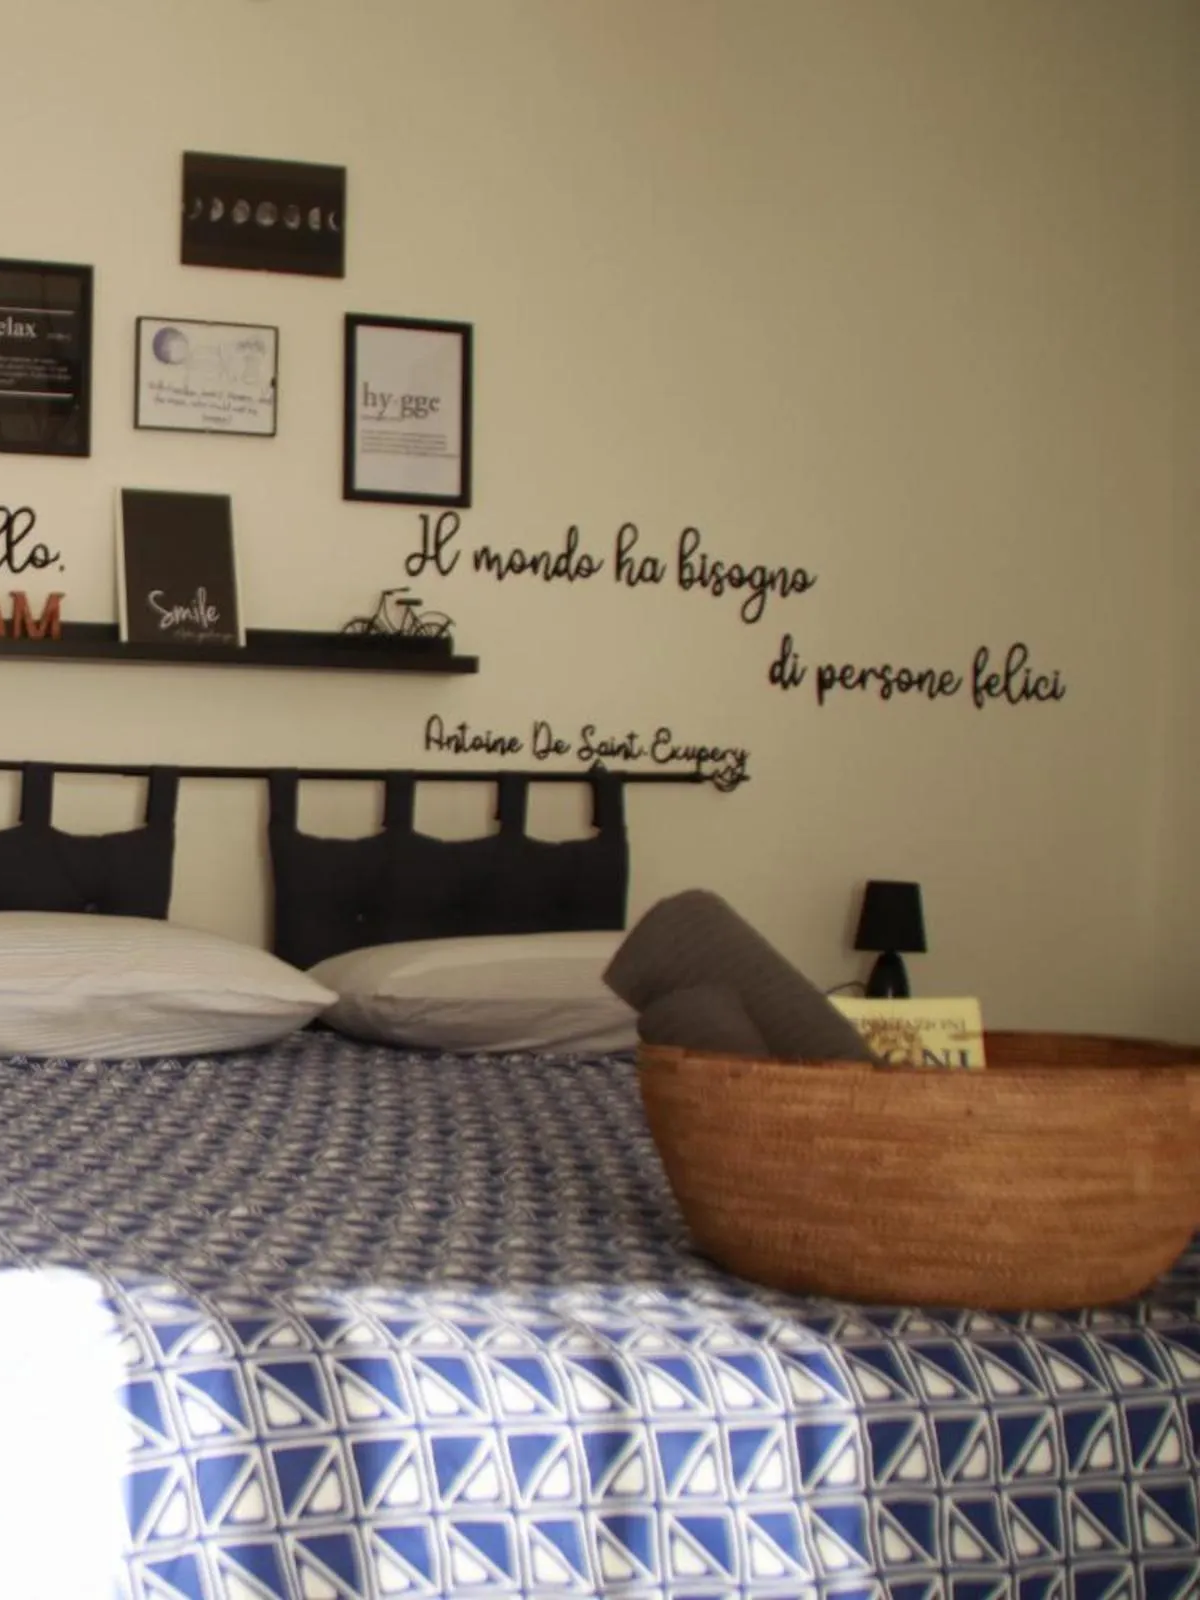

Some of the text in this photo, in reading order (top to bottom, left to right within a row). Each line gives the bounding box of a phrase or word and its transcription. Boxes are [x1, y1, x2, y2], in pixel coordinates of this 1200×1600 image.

[404, 510, 818, 625] Il mondo ha bisogno
[148, 586, 221, 630] Smile
[768, 633, 1066, 710] di persone felici
[424, 714, 524, 756] Antoine
[532, 721, 571, 761] De
